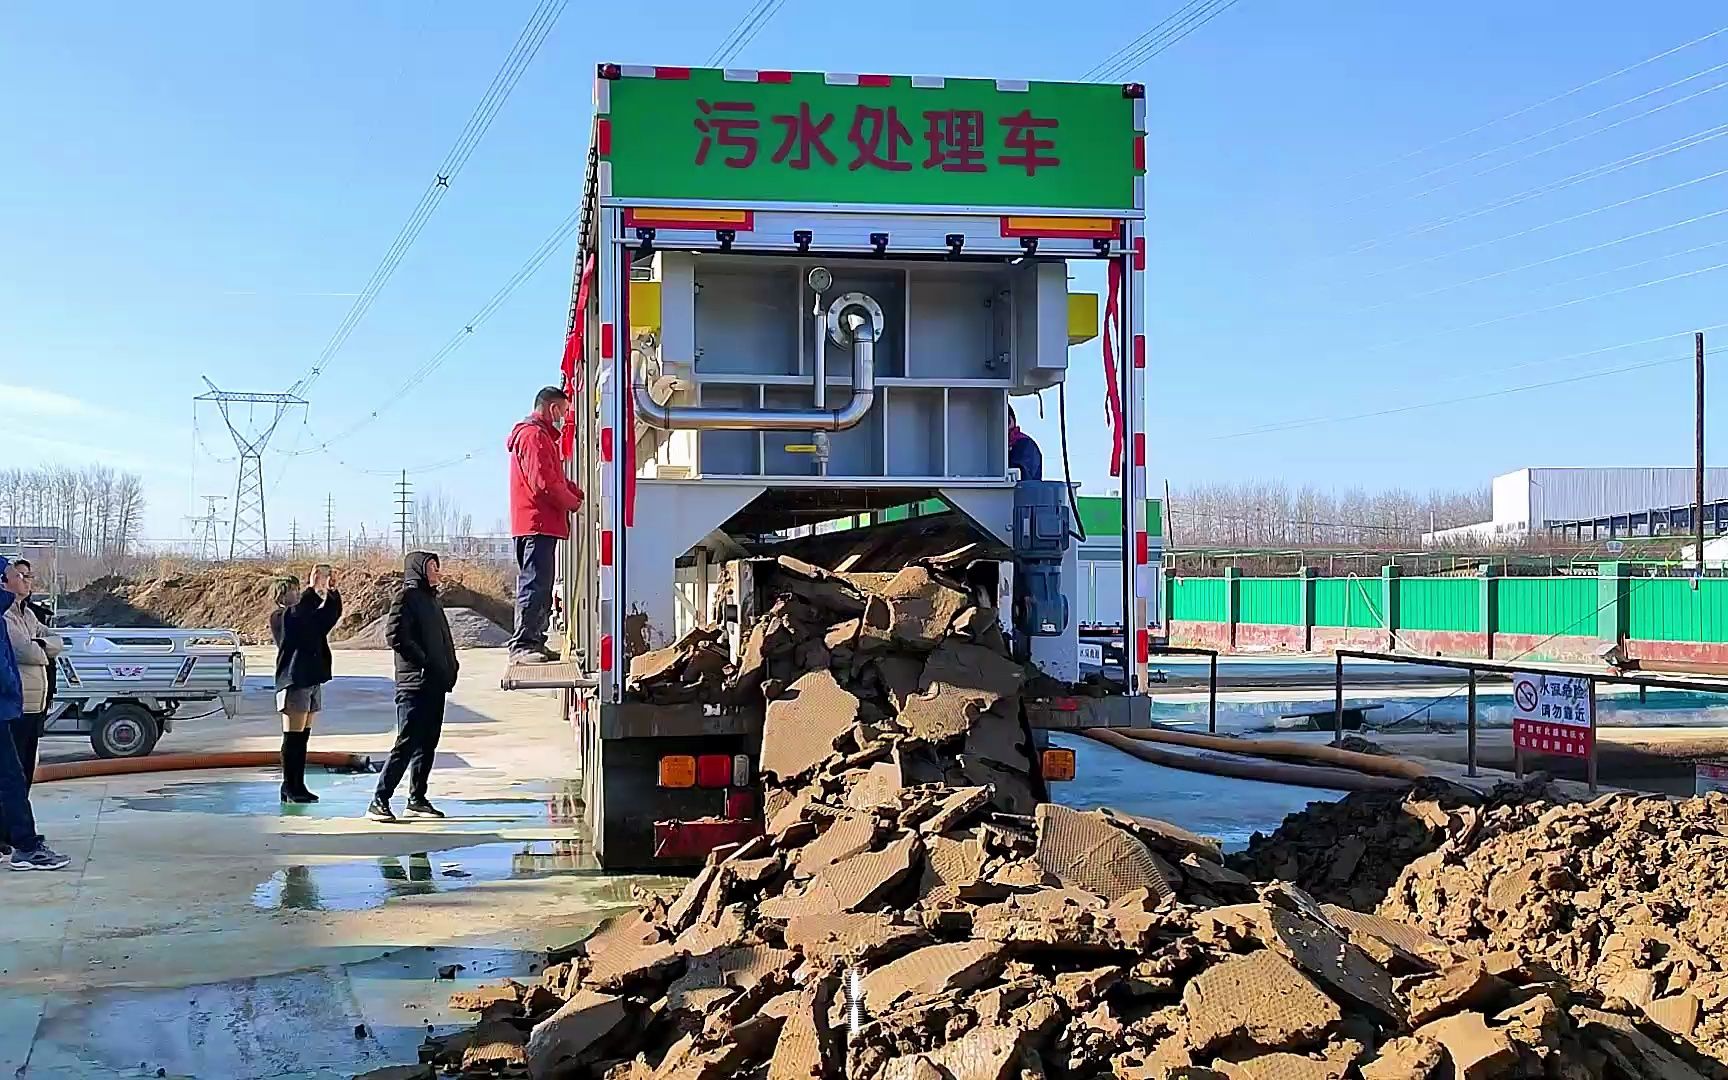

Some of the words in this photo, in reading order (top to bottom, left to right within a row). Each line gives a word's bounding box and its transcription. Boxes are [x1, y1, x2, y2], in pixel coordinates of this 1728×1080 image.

[693, 98, 1061, 177] 污水处理车
[1540, 682, 1585, 699] 水深危险
